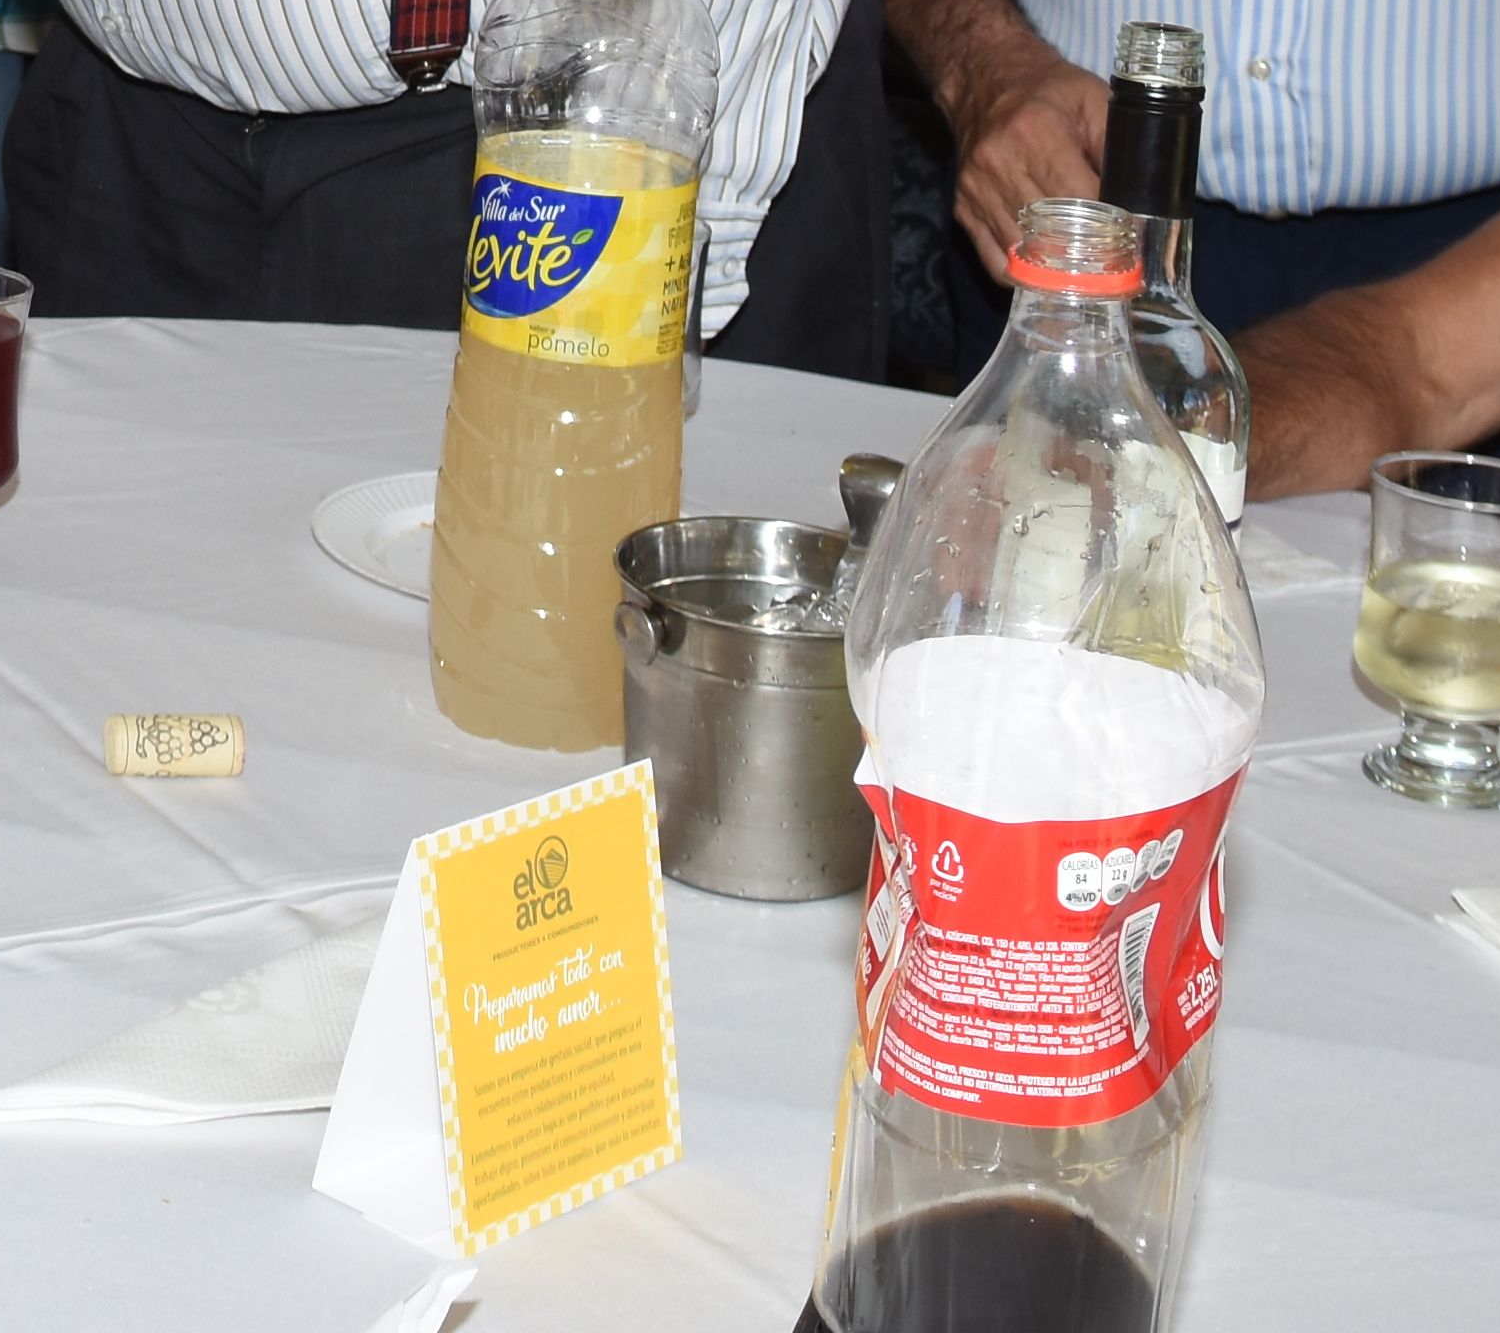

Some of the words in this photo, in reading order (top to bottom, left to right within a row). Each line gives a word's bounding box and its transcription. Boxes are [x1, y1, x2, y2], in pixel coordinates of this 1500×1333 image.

[481, 194, 507, 223] Villa
[508, 207, 524, 222] del
[525, 195, 566, 222] Sur
[527, 334, 610, 359] pomelo
[513, 858, 536, 900] el
[1062, 858, 1099, 871] CALORÍAS
[1075, 873, 1088, 885] 84
[516, 887, 573, 931] arca
[464, 971, 558, 1028] Preparamos
[555, 943, 594, 987] todo
[599, 949, 624, 973] con
[494, 1002, 549, 1054] mucho
